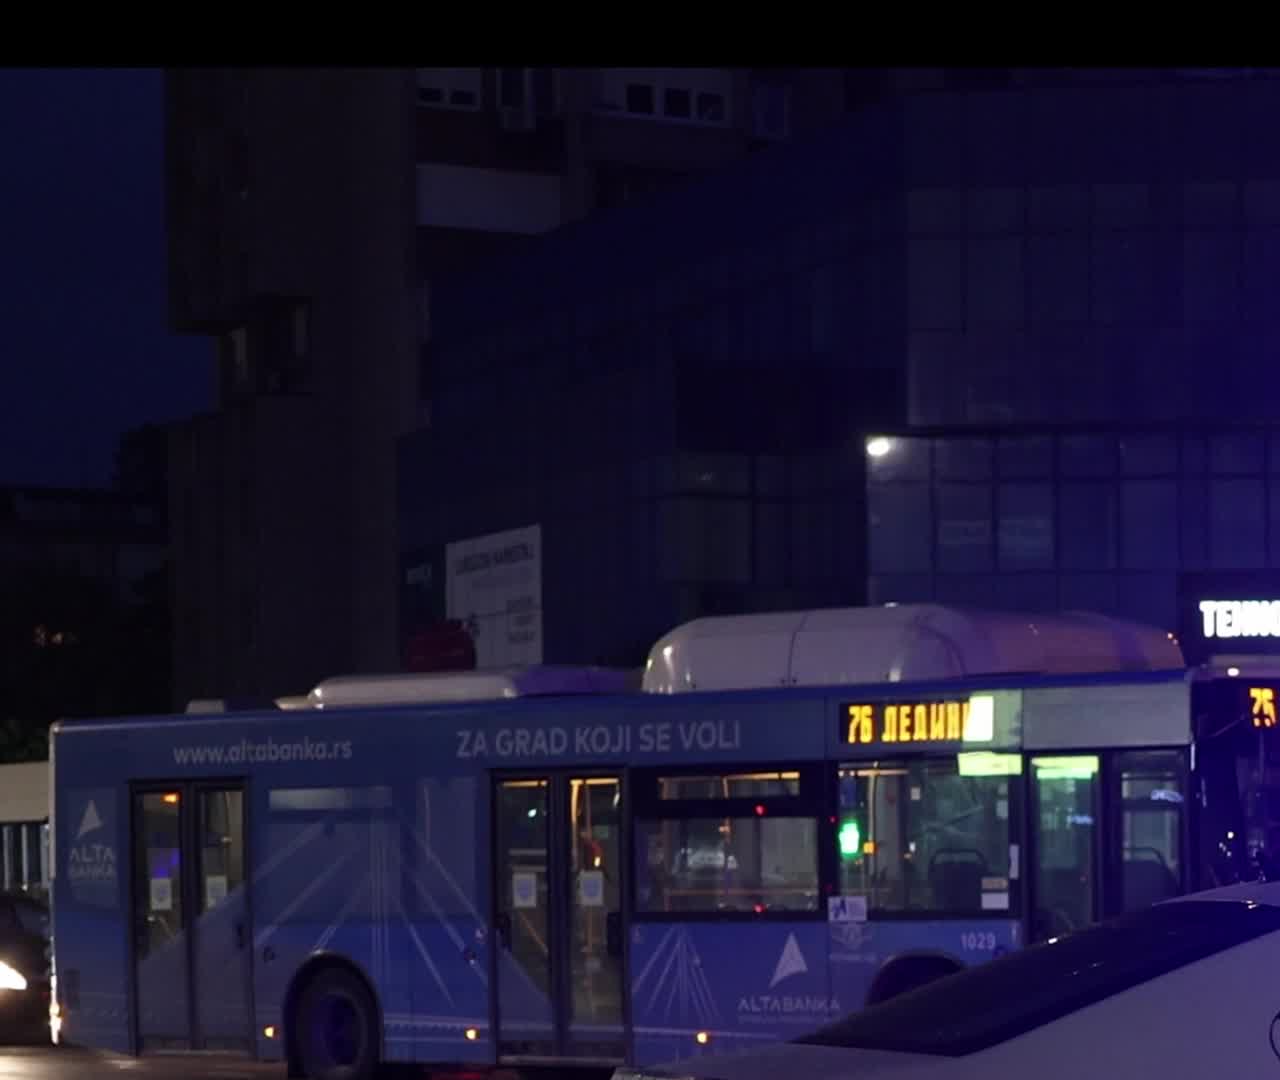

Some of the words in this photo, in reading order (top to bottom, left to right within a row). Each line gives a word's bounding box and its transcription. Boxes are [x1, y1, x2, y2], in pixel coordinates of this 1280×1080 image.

[848, 705, 874, 744] 76
[173, 735, 353, 765] www.altabanka.rs
[455, 729, 489, 759] ZA
[495, 726, 569, 757] GRAD
[575, 723, 632, 753] KOJI
[639, 721, 671, 752] SE
[679, 718, 741, 750] VOLI
[69, 844, 117, 863] ALTA
[961, 931, 997, 950] 1029
[737, 996, 842, 1014] ALTABANKA
